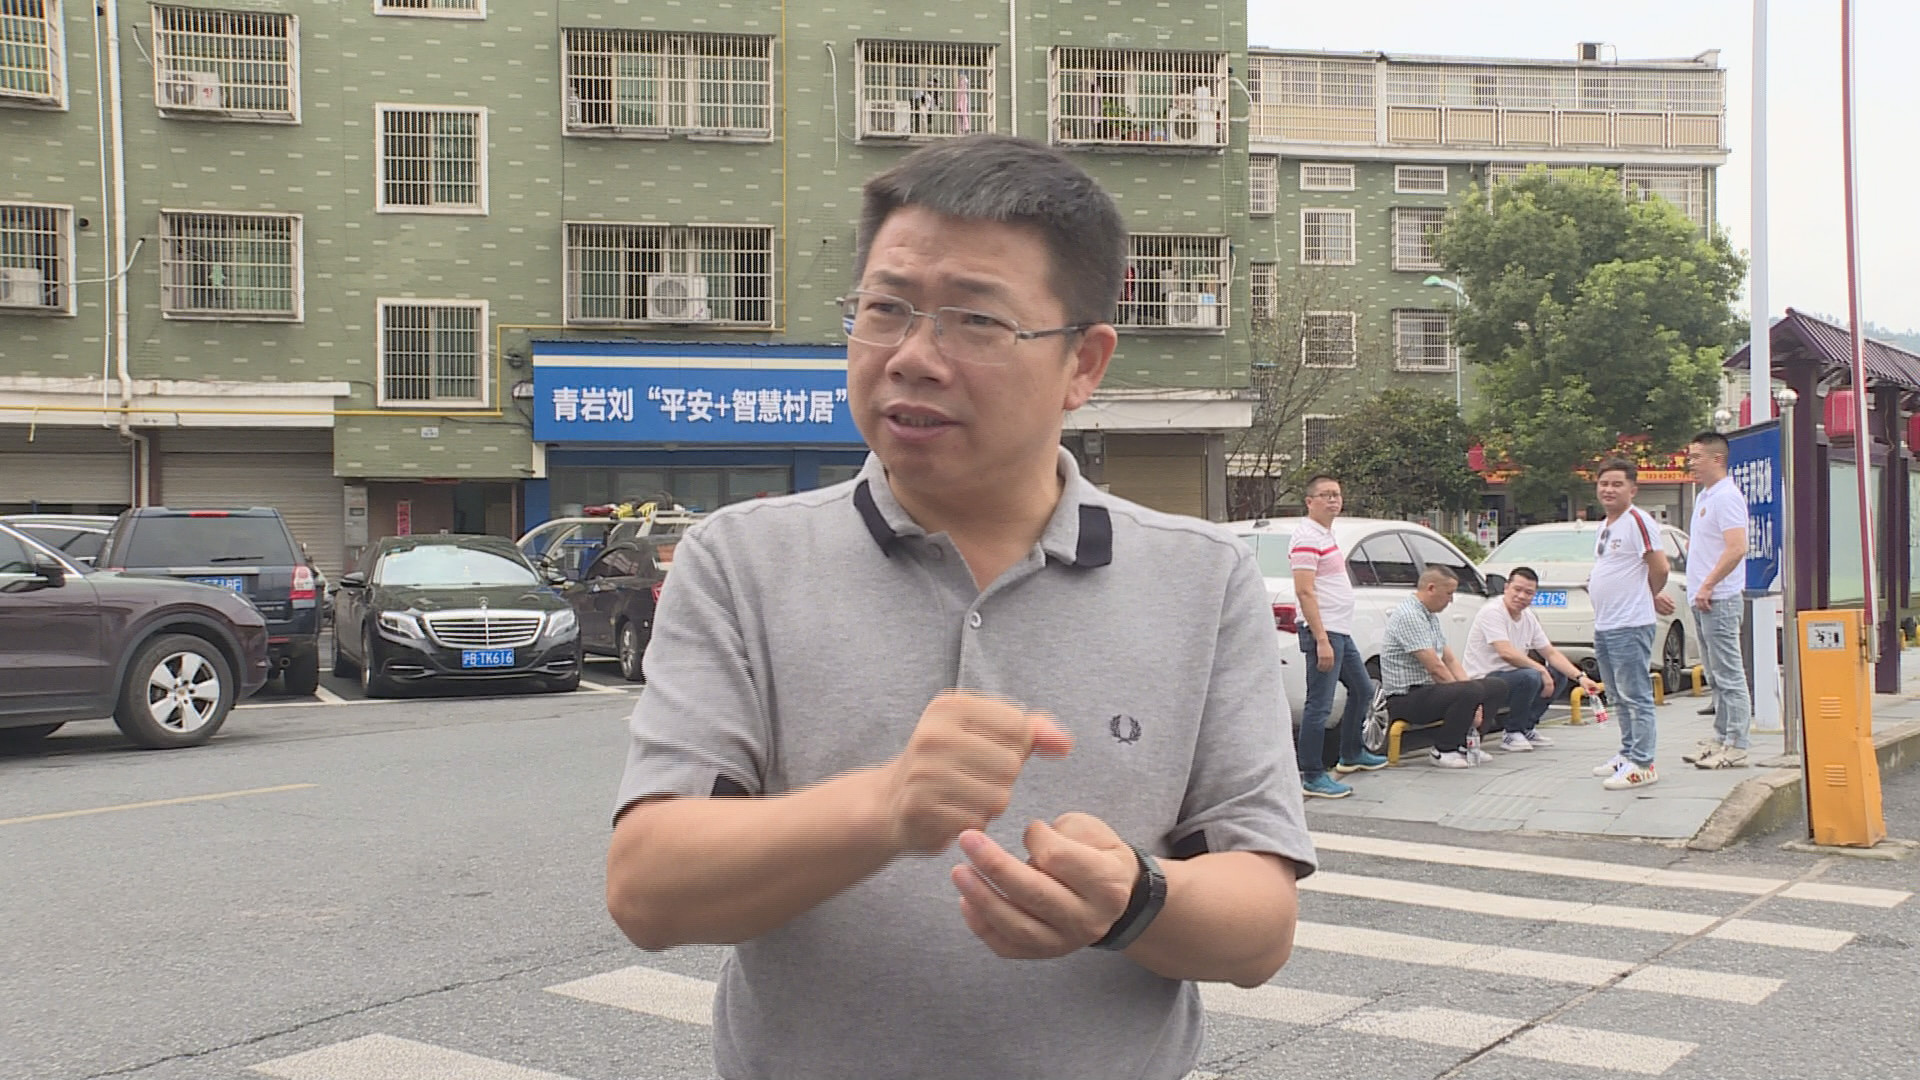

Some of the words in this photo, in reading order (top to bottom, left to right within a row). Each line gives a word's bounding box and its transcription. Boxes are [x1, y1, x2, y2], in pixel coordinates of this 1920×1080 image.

[1728, 456, 1773, 505] 交专用场地
